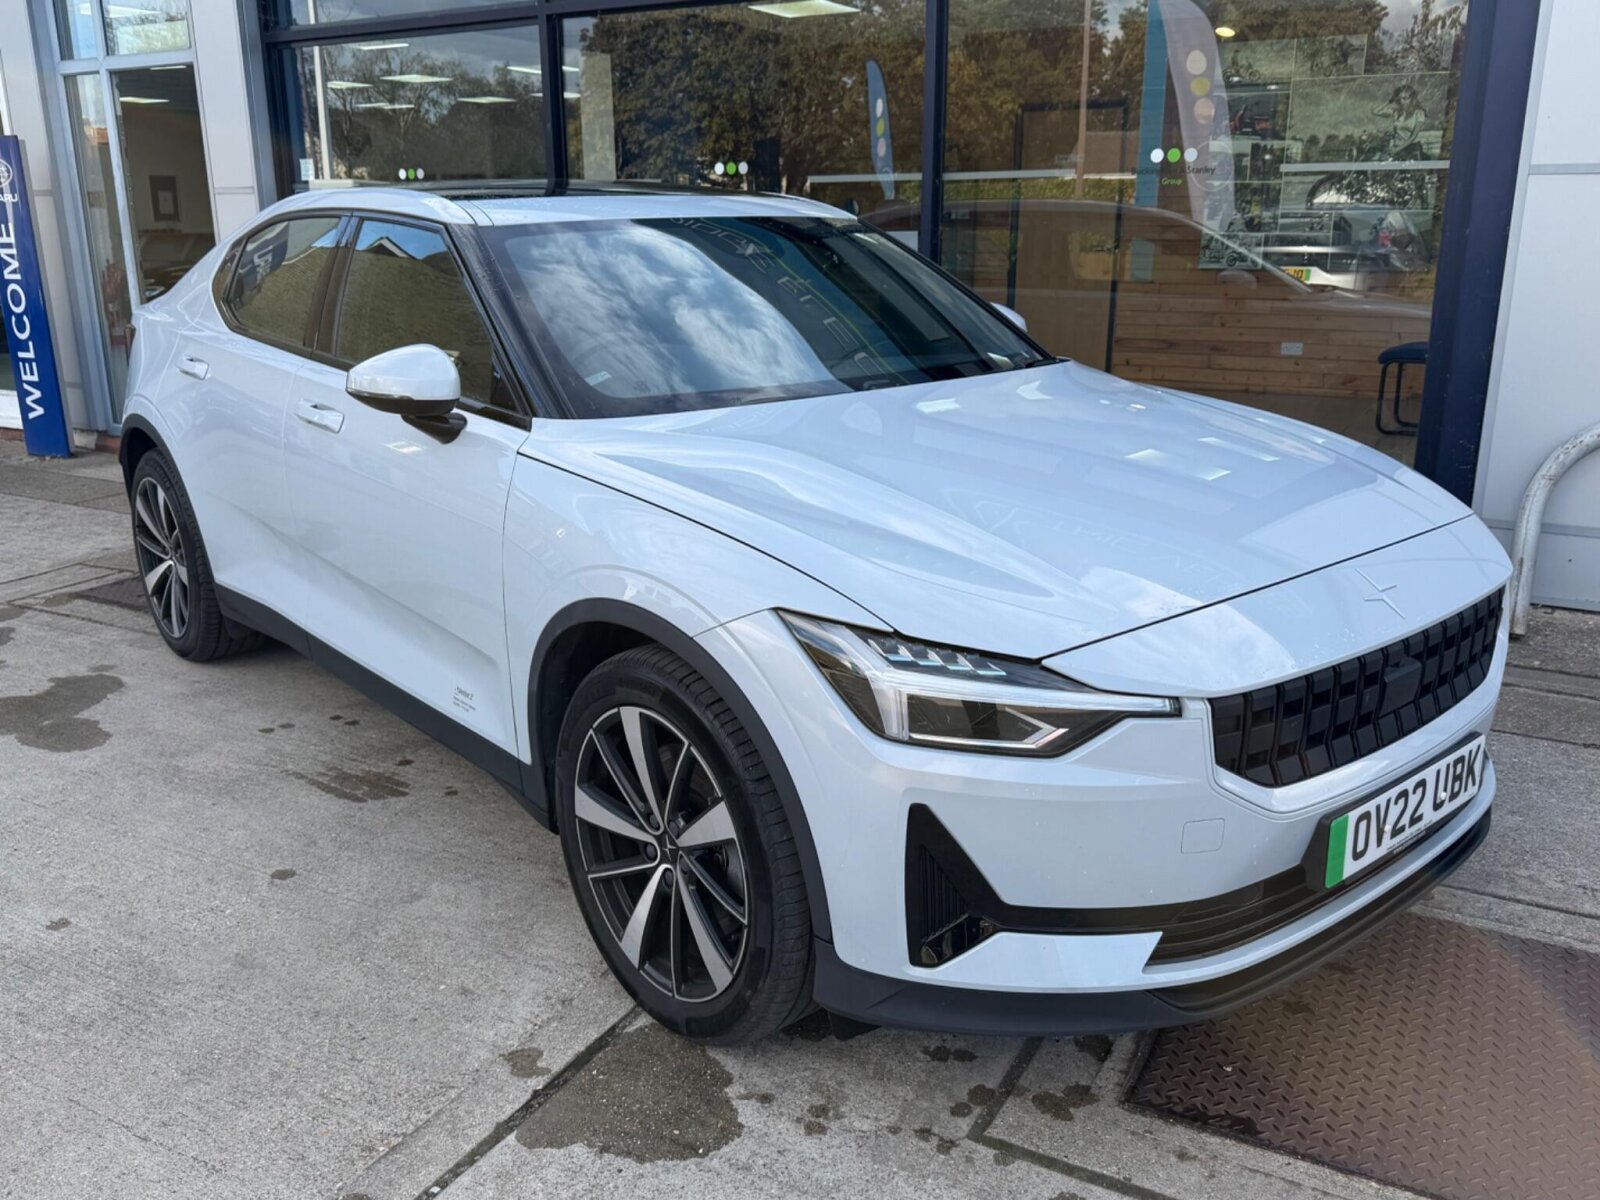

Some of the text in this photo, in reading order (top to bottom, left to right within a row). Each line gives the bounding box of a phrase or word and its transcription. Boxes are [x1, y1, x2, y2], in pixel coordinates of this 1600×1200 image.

[0, 222, 45, 419] WELCOME
[1352, 744, 1481, 862] OV22 UBK
